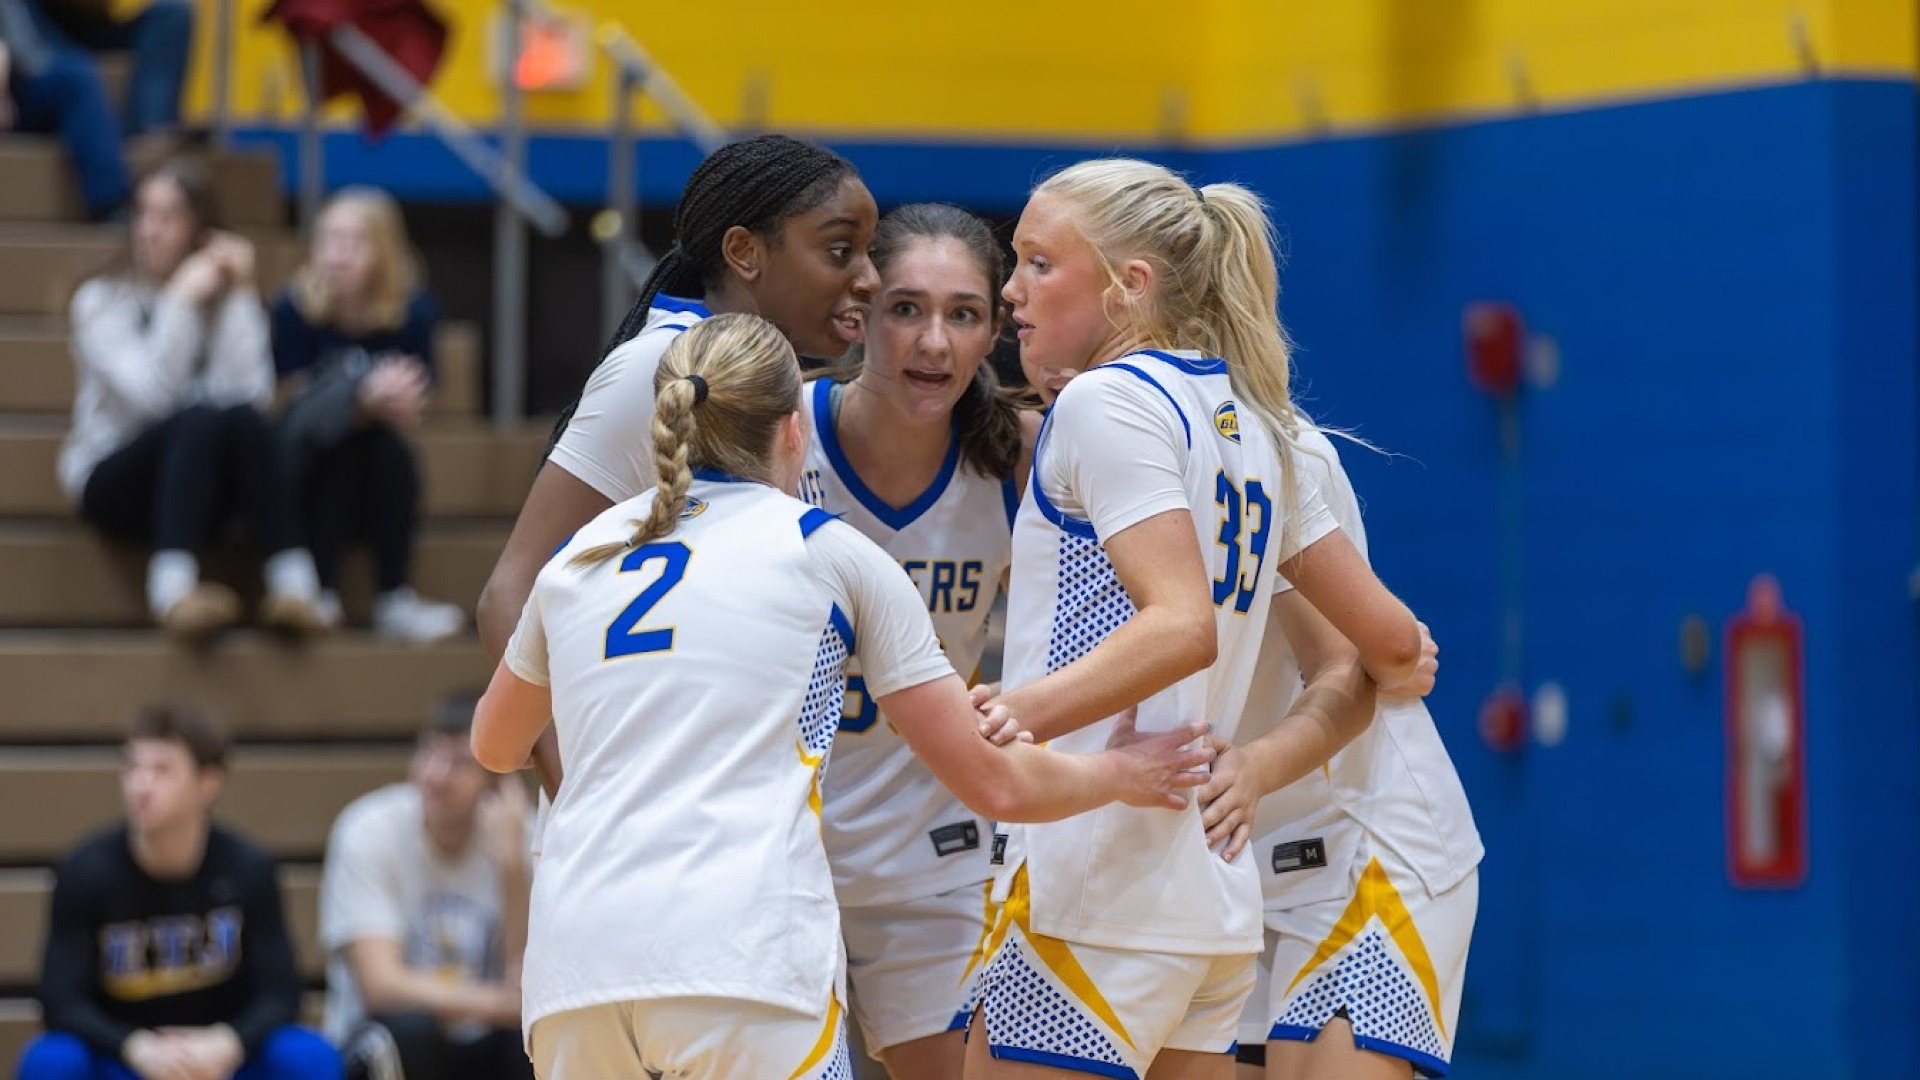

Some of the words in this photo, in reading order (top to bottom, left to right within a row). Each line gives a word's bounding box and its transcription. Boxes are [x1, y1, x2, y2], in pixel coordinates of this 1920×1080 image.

[602, 541, 693, 661] 2
[1213, 467, 1272, 616] 33
[1304, 847, 1319, 860] M
